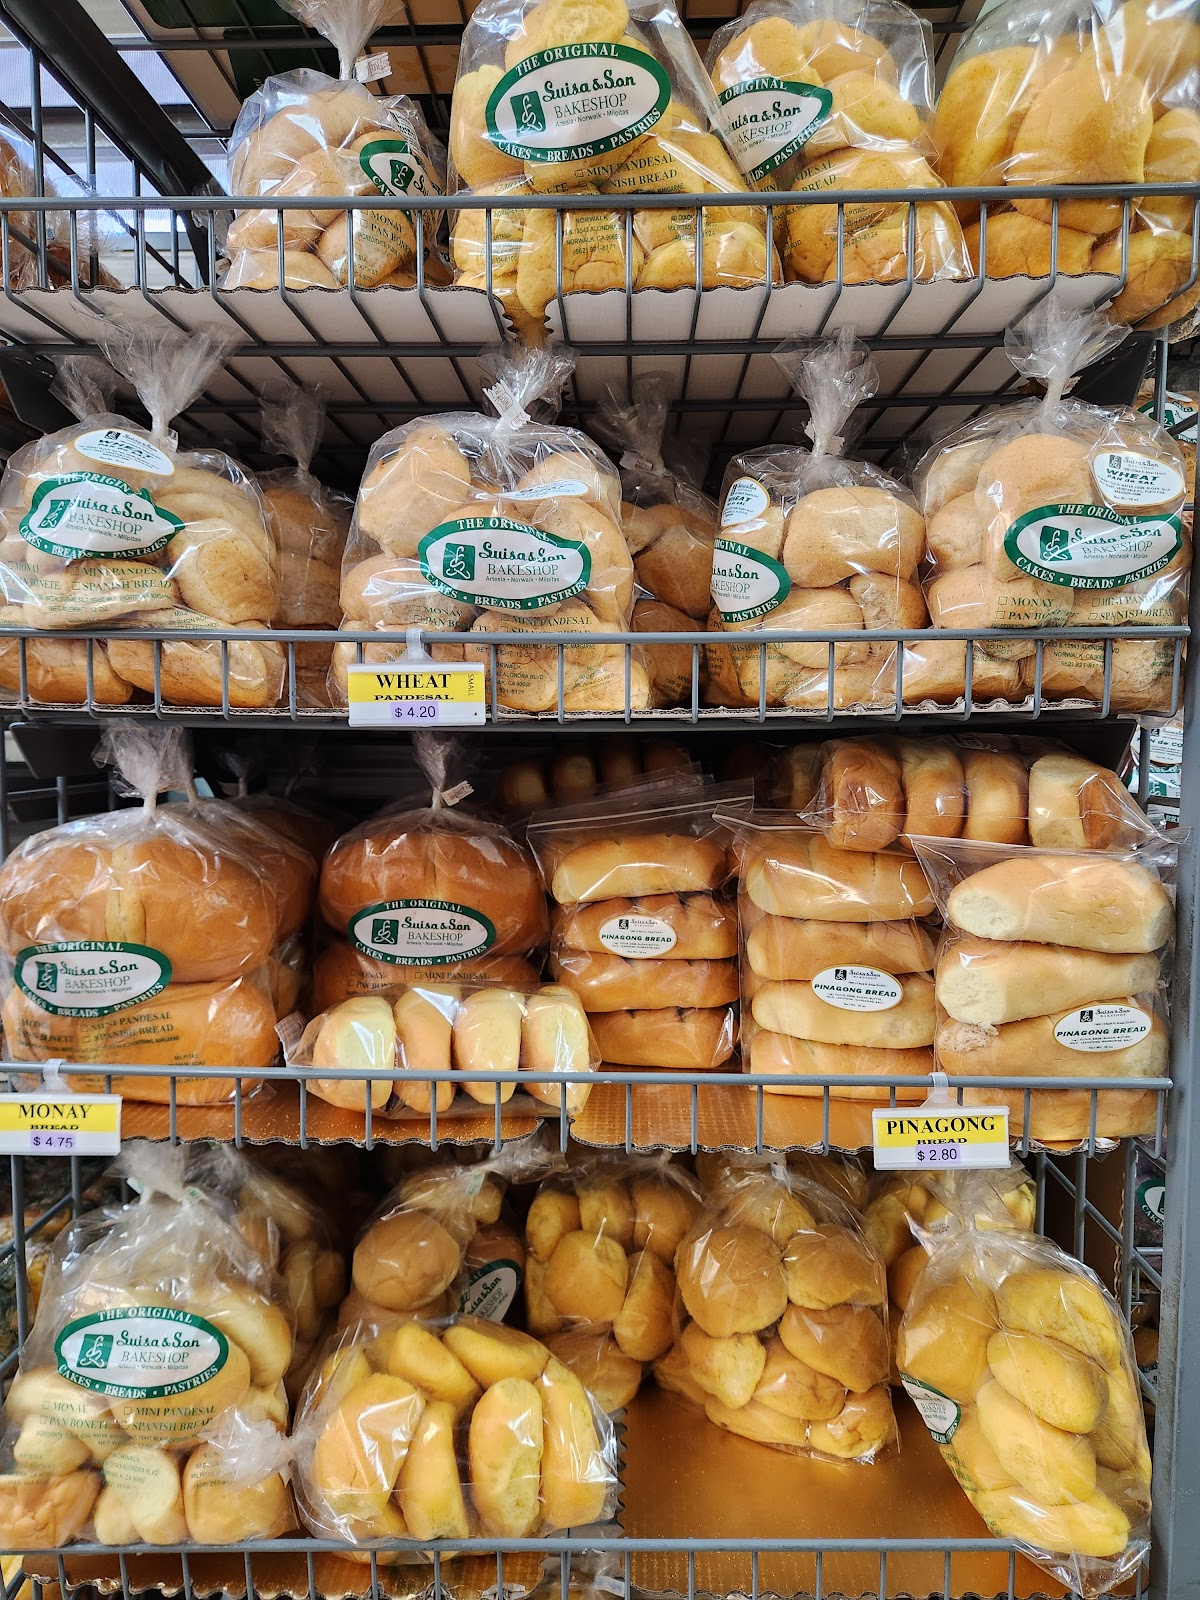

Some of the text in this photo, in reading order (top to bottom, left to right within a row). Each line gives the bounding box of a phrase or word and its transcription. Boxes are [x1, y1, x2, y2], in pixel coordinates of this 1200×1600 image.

[515, 43, 619, 77] THE ORIGINAL
[542, 80, 591, 102] Suisa
[725, 79, 787, 100] ORIGINAL
[553, 93, 627, 119] BAKESHOP
[577, 113, 602, 123] Norwalk
[606, 108, 629, 118] Milpitas
[498, 107, 661, 162] CAKES BREADS PASTRIES
[735, 121, 792, 145] AKESHOP
[774, 118, 822, 166] PASTRIES
[586, 153, 676, 177] MINI PANDESAL
[639, 169, 677, 184] BREAD
[372, 176, 395, 197] CAK
[575, 215, 608, 224] NORWALK
[370, 223, 390, 239] PAN
[1106, 468, 1160, 481] WHEAT
[81, 472, 131, 494] ORIGIN
[1058, 504, 1142, 526] THE ORIGINAL
[69, 512, 142, 535] BAKESHOP
[457, 518, 551, 542] THE ORIGINAL
[88, 528, 113, 538] Norwalk
[19, 525, 41, 548] CAKES
[112, 537, 168, 559] PASTRIES
[1081, 541, 1153, 554] BAKESHOP
[479, 541, 528, 562] Suisa
[487, 563, 559, 576] BAKESHOP
[1016, 555, 1169, 589] CAKES BREADS PASTRIES
[82, 580, 171, 592] SPANISH BREAD
[425, 572, 587, 609] CAKES BREADS PASTRIES
[711, 580, 751, 594] AKESHOP
[732, 598, 779, 622] PASTRIES
[1011, 598, 1054, 608] MONAY
[424, 606, 462, 617] MONAY
[1008, 612, 1032, 620] PAN
[1145, 608, 1175, 617] BREAD
[425, 616, 445, 626] PAN
[512, 616, 592, 626] MINI PANDESAL
[376, 673, 451, 688] WHEAT
[394, 706, 436, 718] $ 4.20
[385, 900, 463, 913] THE ORIGINAL
[401, 917, 438, 930] Suisa
[408, 932, 463, 942] BAKESHOP
[35, 942, 124, 954] THE ORIGINAL
[355, 941, 487, 966] CAKES BREADS PASTRIES
[65, 975, 131, 989] BAKESHOP
[447, 972, 489, 980] PANDESAL
[814, 984, 897, 998] PINAGONG BREAD
[57, 1007, 99, 1017] BREADS
[113, 983, 164, 1012] PASTRIES
[119, 1012, 172, 1026] PANDESAL
[139, 1024, 174, 1035] BREAD
[1056, 1026, 1147, 1037] PINAGONG BREAD
[18, 1104, 92, 1119] MONAY
[886, 1116, 995, 1136] PINAGONG
[33, 1136, 73, 1148] $ 4.75
[916, 1137, 968, 1145] BREAD
[917, 1148, 957, 1161] $ 2.80
[1141, 1204, 1165, 1227] CAKE
[98, 1307, 193, 1324] THE ORIGINAL
[116, 1330, 159, 1348] Suisa
[121, 1351, 189, 1364] BAKESHOP
[58, 1363, 219, 1399] CAKES BREADS PASTRIES
[53, 1402, 216, 1417] MONAY MINI PANDESAL
[50, 1417, 67, 1427] PAN
[69, 1418, 111, 1429] BONETE
[132, 1420, 176, 1432] SPANISH
[145, 1467, 160, 1476] BLVD
